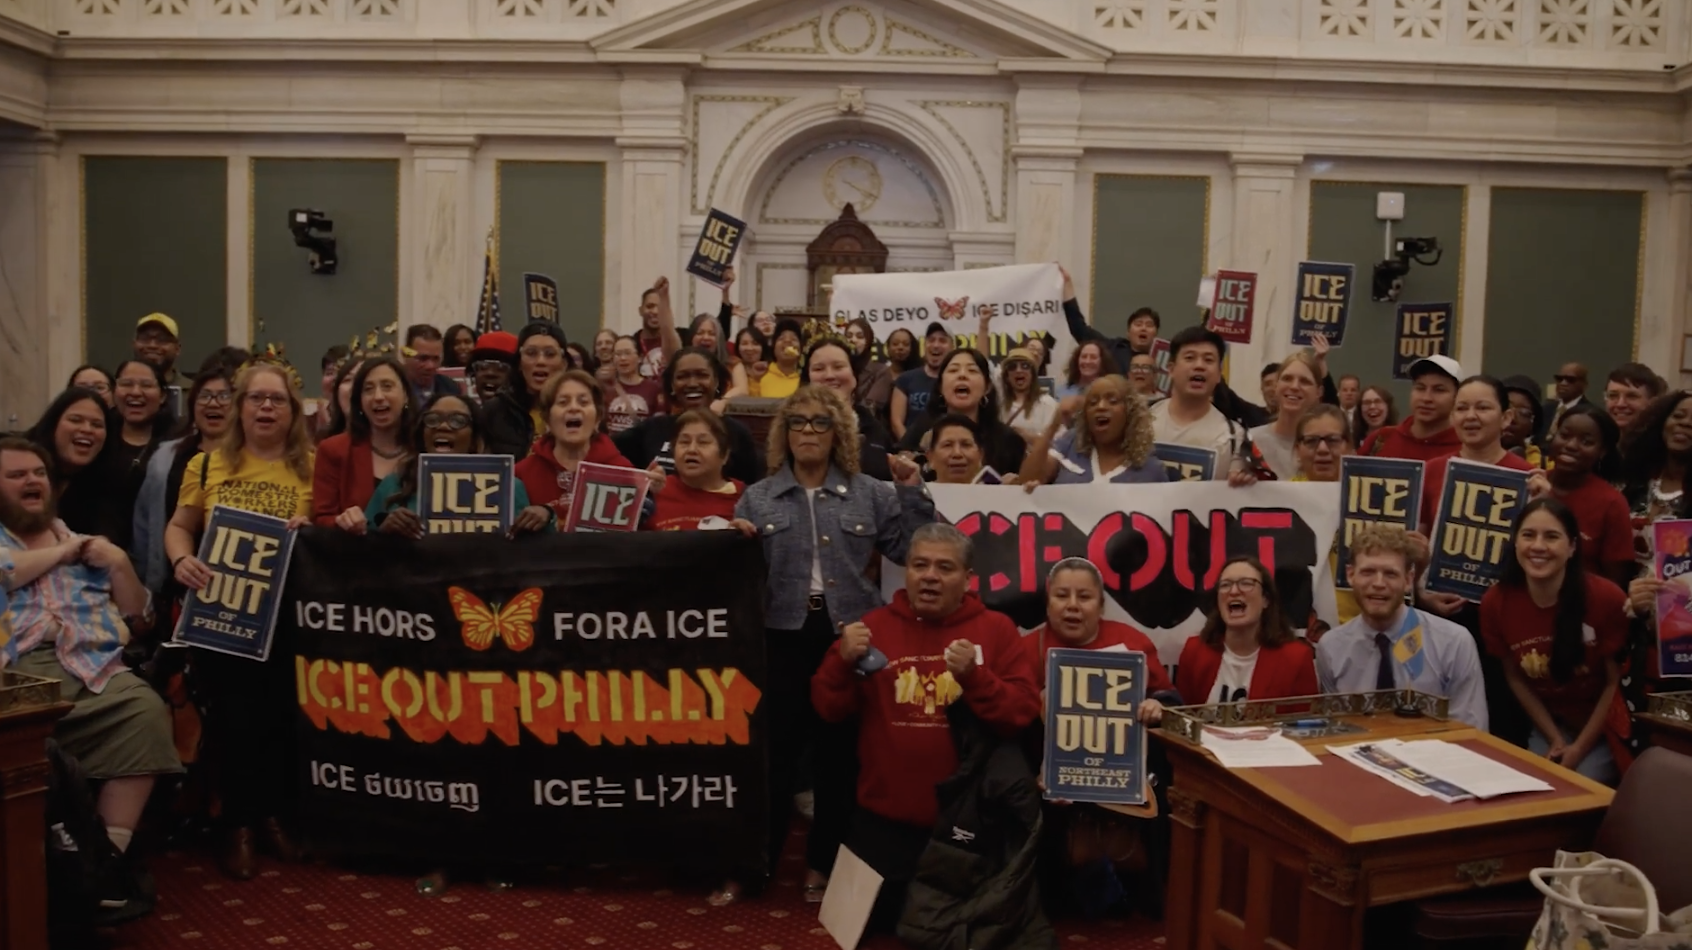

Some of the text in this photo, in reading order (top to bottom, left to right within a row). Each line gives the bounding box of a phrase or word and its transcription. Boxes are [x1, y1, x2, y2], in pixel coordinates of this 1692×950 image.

[705, 217, 739, 247] ICE
[698, 237, 732, 264] OUT
[529, 281, 556, 306] ICE
[1219, 279, 1251, 302] ICE
[1303, 273, 1346, 300] ICE
[530, 301, 558, 322] OUT
[883, 307, 929, 323] DEYO
[1214, 302, 1249, 323] OUT
[1300, 299, 1343, 324] OUT
[1402, 311, 1447, 336] ICE
[1399, 336, 1445, 358] OUT
[217, 487, 300, 501] DOMESTIC
[222, 480, 297, 495] NATIONAL
[430, 472, 501, 515] ICE
[1348, 475, 1410, 518] ICE
[579, 482, 638, 526] ICE
[1450, 480, 1518, 528] ICE
[208, 525, 280, 578] ICE
[953, 510, 1293, 593] CE OUT
[1442, 521, 1511, 565] OUT
[1439, 567, 1500, 588] PHILLY
[1462, 562, 1481, 572] OF
[195, 570, 271, 616] OUT
[191, 616, 259, 640] PHILLY
[218, 611, 238, 622] OF
[296, 600, 436, 642] ICE HORS
[553, 608, 728, 641] FORA ICE
[295, 655, 738, 723] ICE OUT PHILLY
[1058, 665, 1133, 713] ICE
[1055, 713, 1134, 756] OUT
[1058, 766, 1132, 778] NORTHEAST
[1083, 757, 1105, 767] OF
[310, 760, 357, 792] ICE
[1057, 774, 1131, 789] PHILLY
[533, 774, 737, 808] ICE는 나가라
